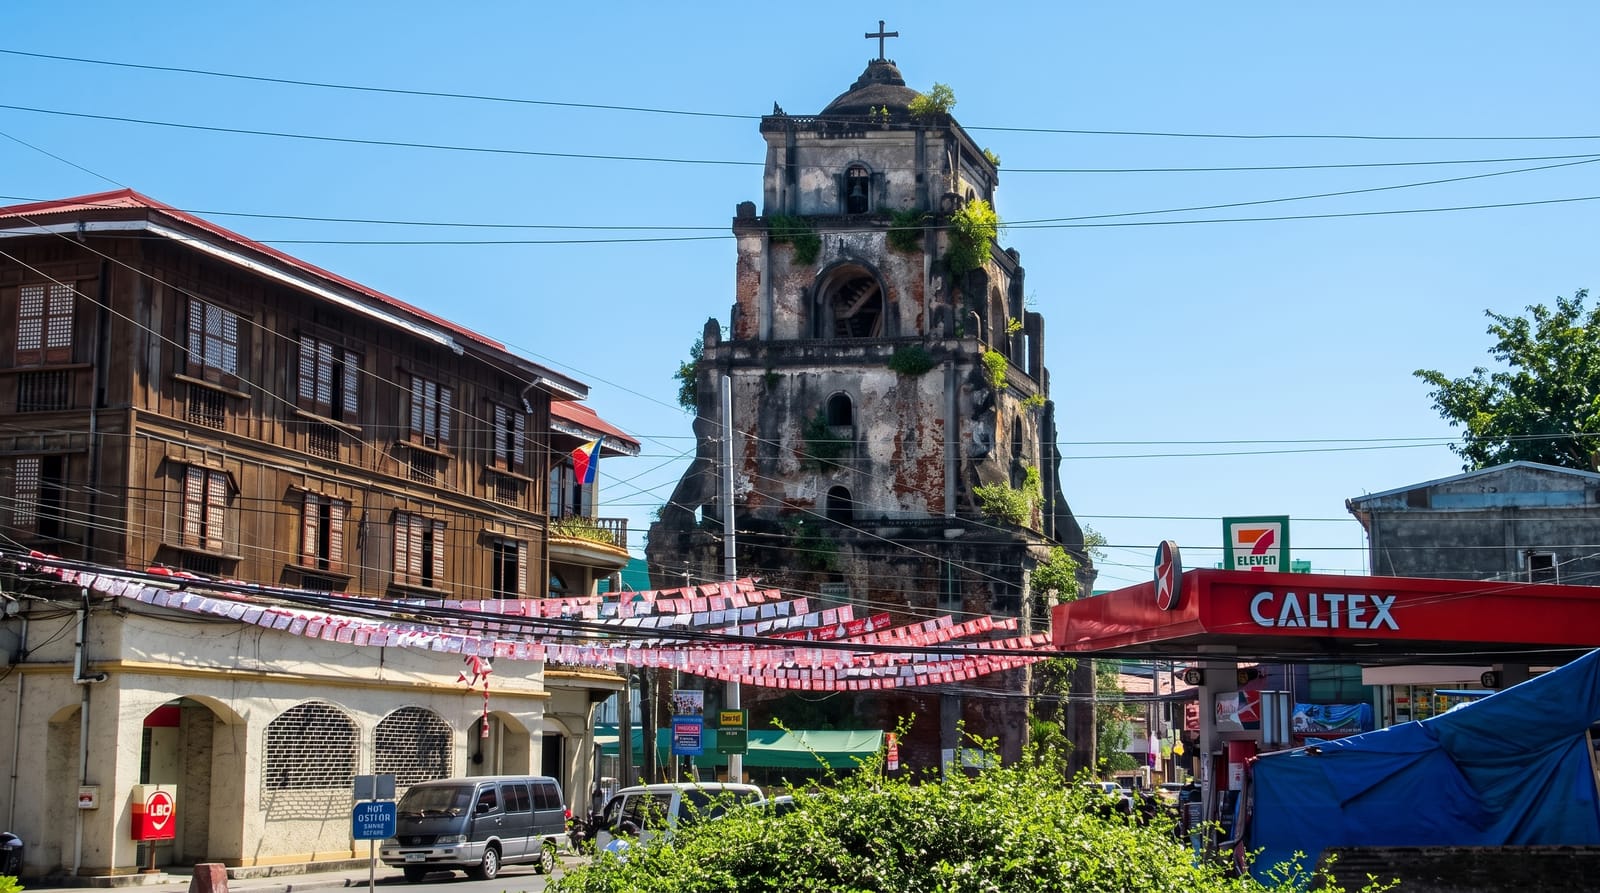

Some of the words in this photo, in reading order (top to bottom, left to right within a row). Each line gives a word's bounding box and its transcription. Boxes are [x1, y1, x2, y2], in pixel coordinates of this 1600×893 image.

[1238, 529, 1275, 572] 7
[1250, 591, 1400, 630] CALTEX
[150, 804, 172, 817] LBC
